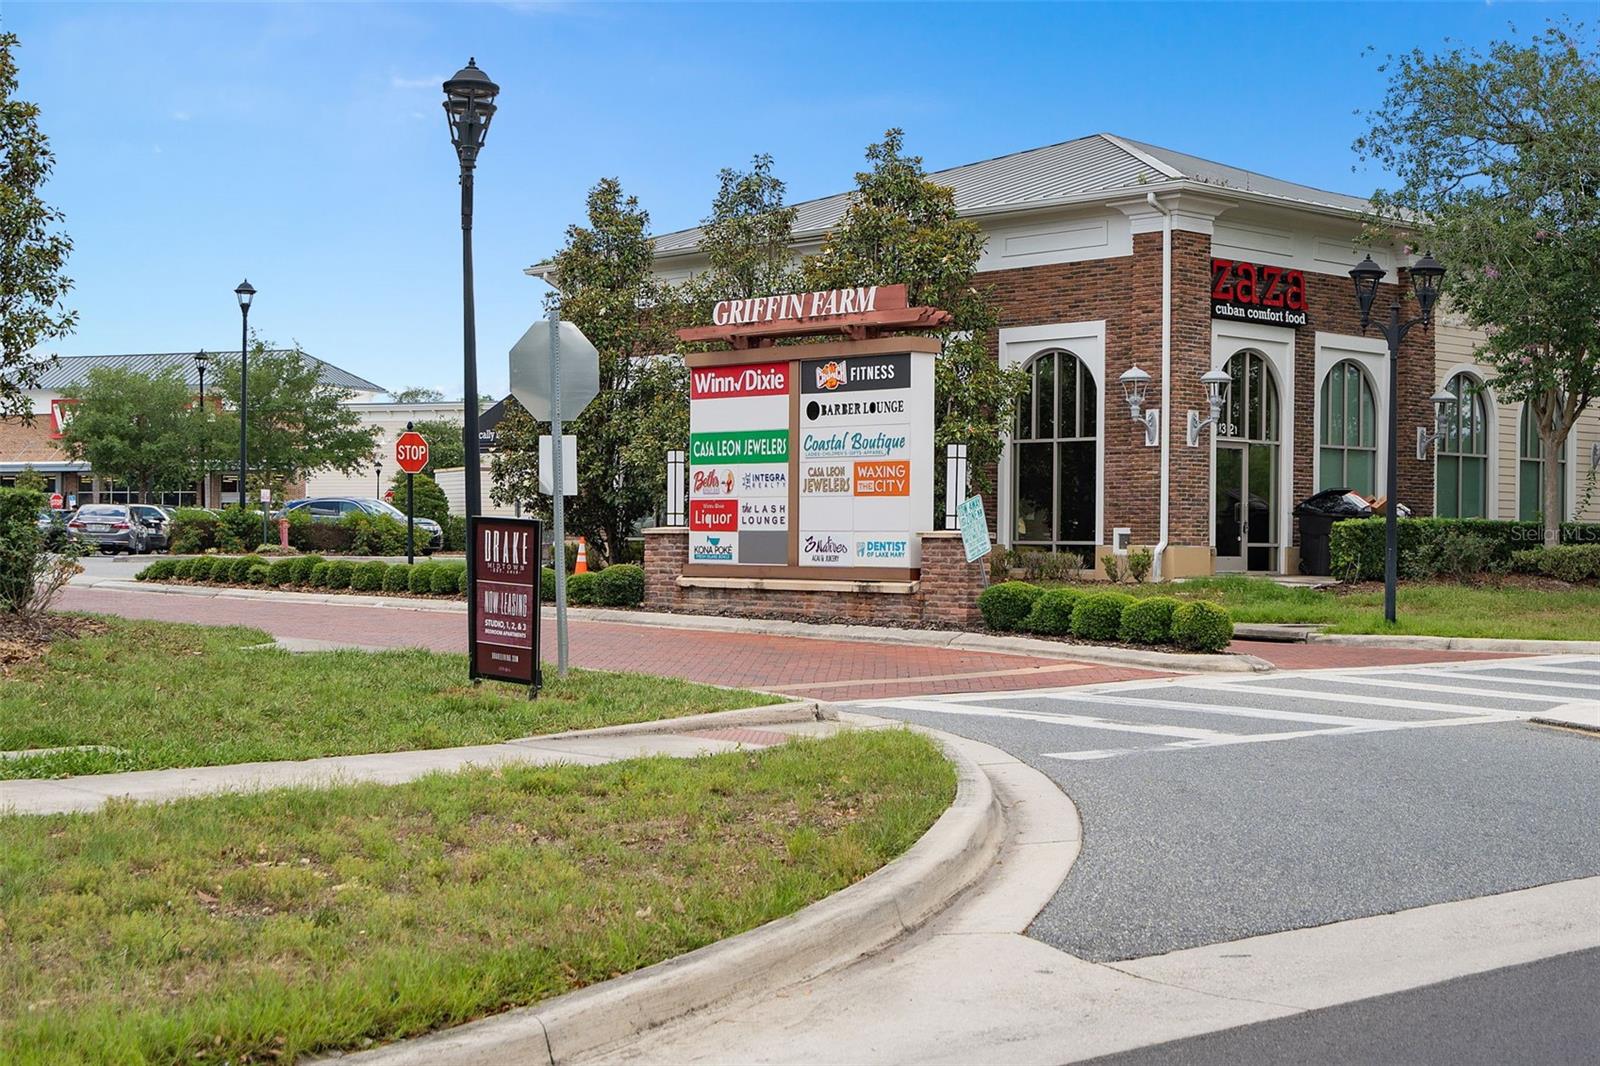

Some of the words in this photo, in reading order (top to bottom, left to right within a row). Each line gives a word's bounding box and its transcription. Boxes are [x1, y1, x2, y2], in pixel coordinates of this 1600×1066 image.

[1212, 258, 1309, 310] zaza
[712, 292, 806, 326] GRIFFIN
[809, 285, 878, 318] FARM
[1215, 303, 1245, 317] cuban
[1247, 308, 1283, 323] comfort
[1285, 311, 1306, 325] food
[850, 364, 895, 381] FITNESS
[820, 402, 861, 416] BARBER
[863, 400, 904, 414] LOUNGE
[693, 441, 714, 457] CASA
[717, 439, 741, 457] LEON
[743, 438, 787, 456] JEWELERS
[804, 431, 849, 452] Coastal
[851, 432, 905, 455] Boutique
[398, 445, 426, 460] STOP
[752, 473, 786, 482] INTEGRA
[807, 467, 825, 477] CASA
[826, 466, 846, 477] LEON
[857, 465, 905, 478] WAXING
[803, 477, 850, 493] JEWELERS
[859, 482, 873, 491] THE
[874, 480, 905, 492] CITY
[742, 503, 752, 514] the
[754, 505, 786, 513] LASH
[695, 510, 732, 528] Liquor
[741, 516, 786, 525] LOUNGE
[484, 530, 528, 565] DRAKE
[694, 545, 713, 554] KONA
[714, 544, 733, 554] POKÉ
[804, 536, 816, 553] 3
[815, 536, 848, 553] Natives
[866, 541, 907, 551] DENTIST
[487, 563, 525, 571] MIDTOWN
[484, 590, 499, 614] NOW
[500, 592, 527, 617] LEASING
[484, 619, 506, 630] STUDIO,
[506, 621, 511, 630] 1,
[511, 622, 517, 631] 2,
[517, 623, 522, 631] &
[522, 623, 527, 631] 3
